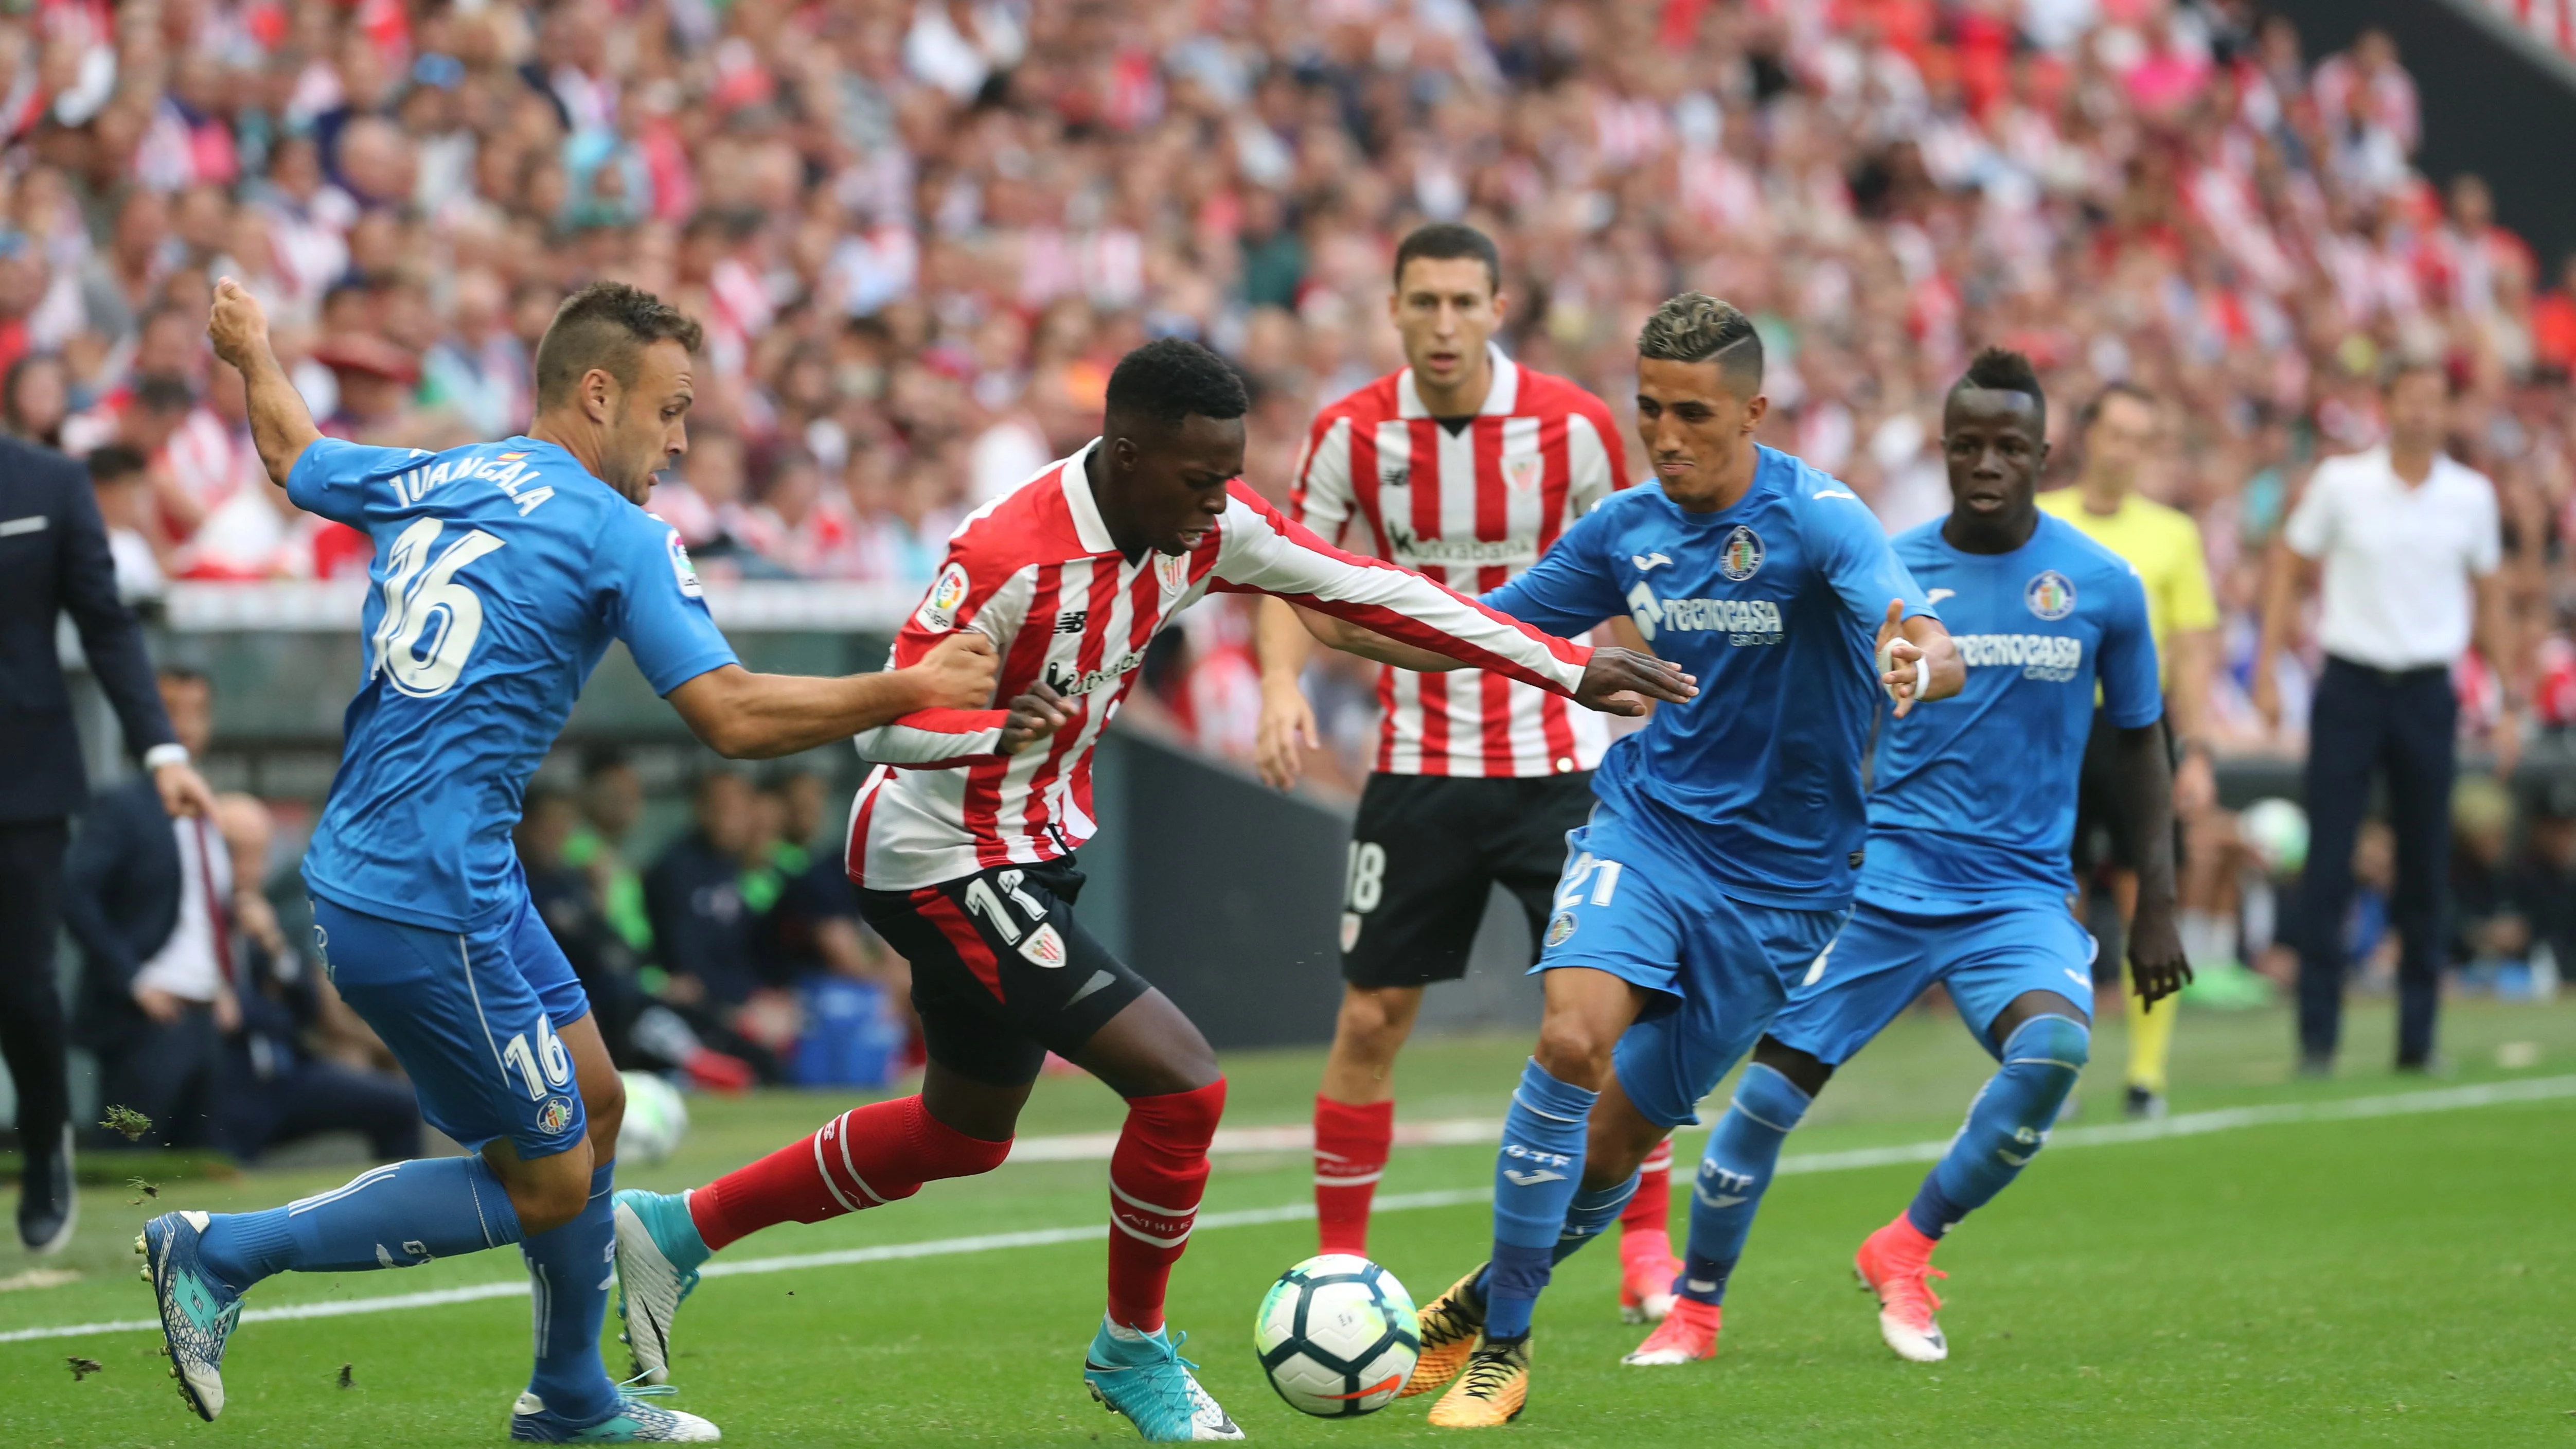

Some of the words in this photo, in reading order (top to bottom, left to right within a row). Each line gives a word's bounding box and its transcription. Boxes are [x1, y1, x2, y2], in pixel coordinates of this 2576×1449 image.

[370, 516, 507, 698] 16
[1662, 598, 1783, 632] TECNOCASA
[1729, 633, 1784, 647] GROUP
[1342, 840, 1387, 913] 18
[1555, 851, 1623, 911] 21
[503, 1013, 569, 1102] 16
